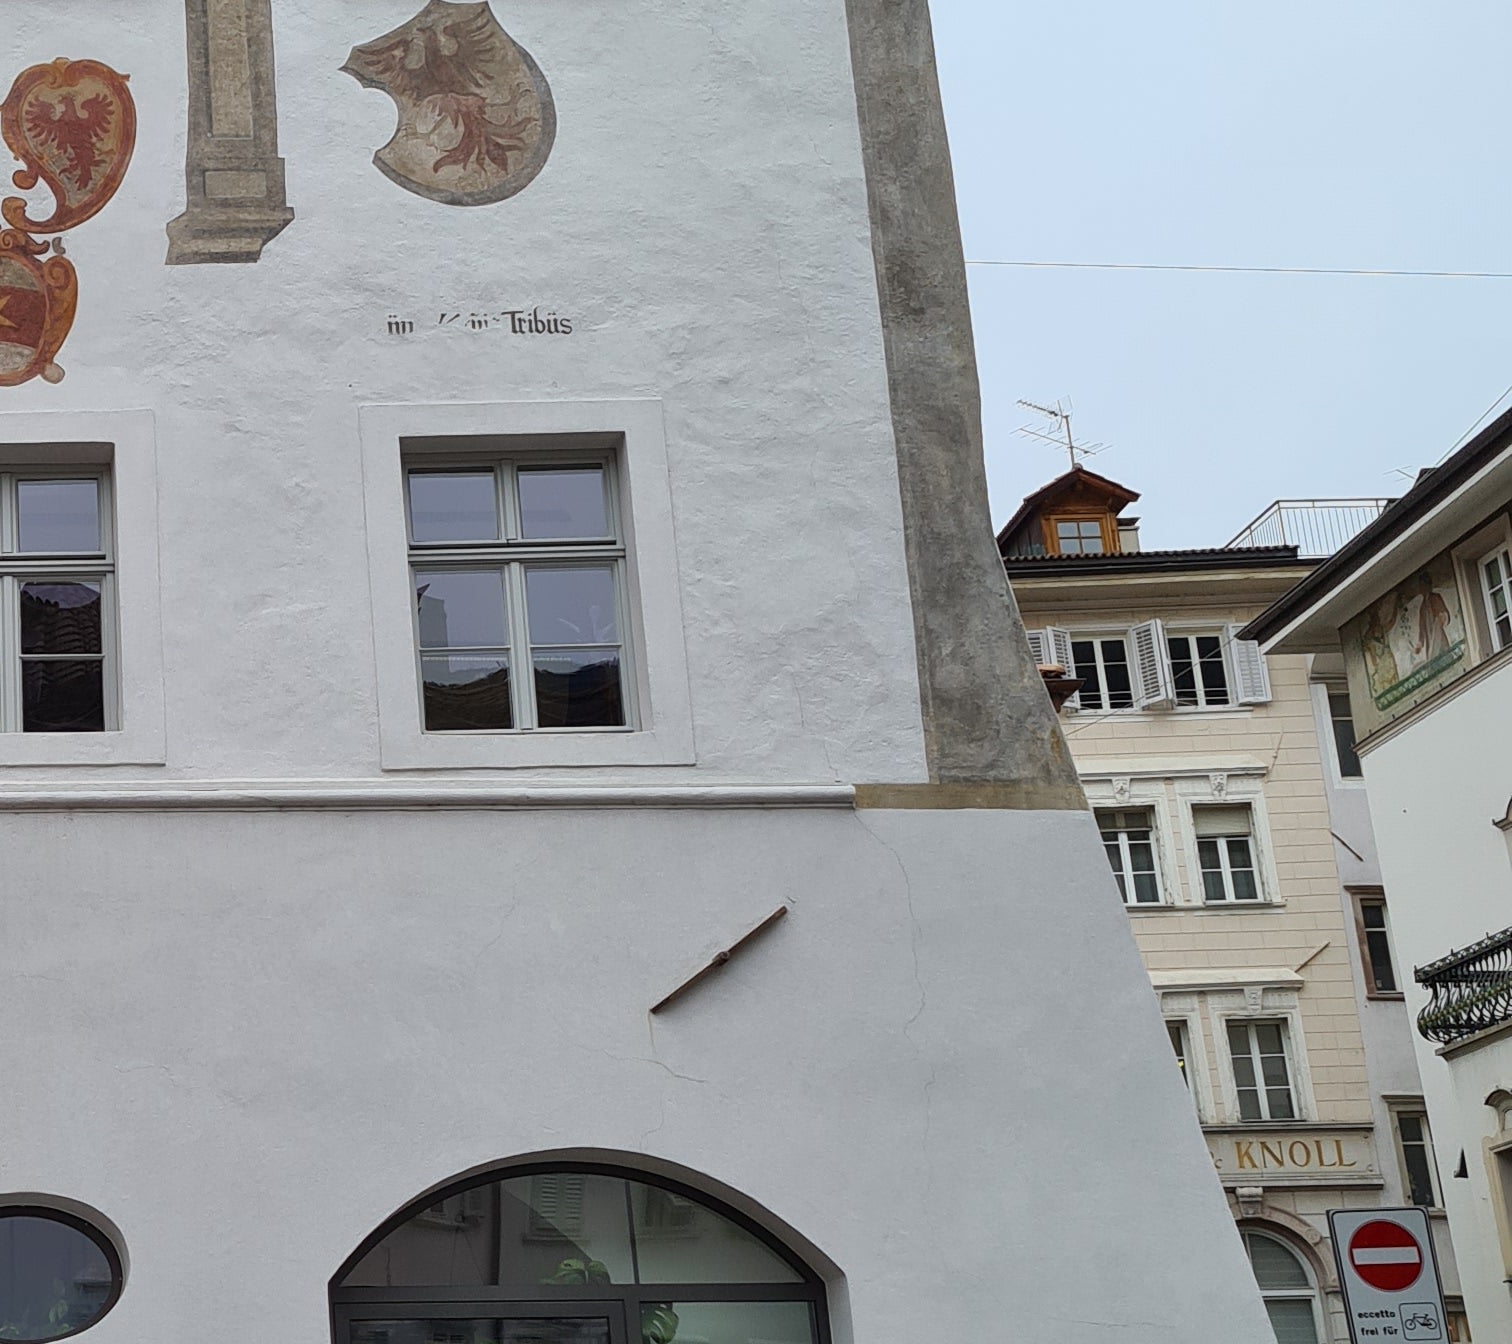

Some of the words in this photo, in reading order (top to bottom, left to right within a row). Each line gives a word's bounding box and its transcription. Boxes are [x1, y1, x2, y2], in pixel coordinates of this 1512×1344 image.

[1234, 1139, 1357, 1169] KNOLL
[1357, 1310, 1396, 1319] eccetto
[1360, 1327, 1379, 1336] frei
[1383, 1325, 1398, 1335] für
